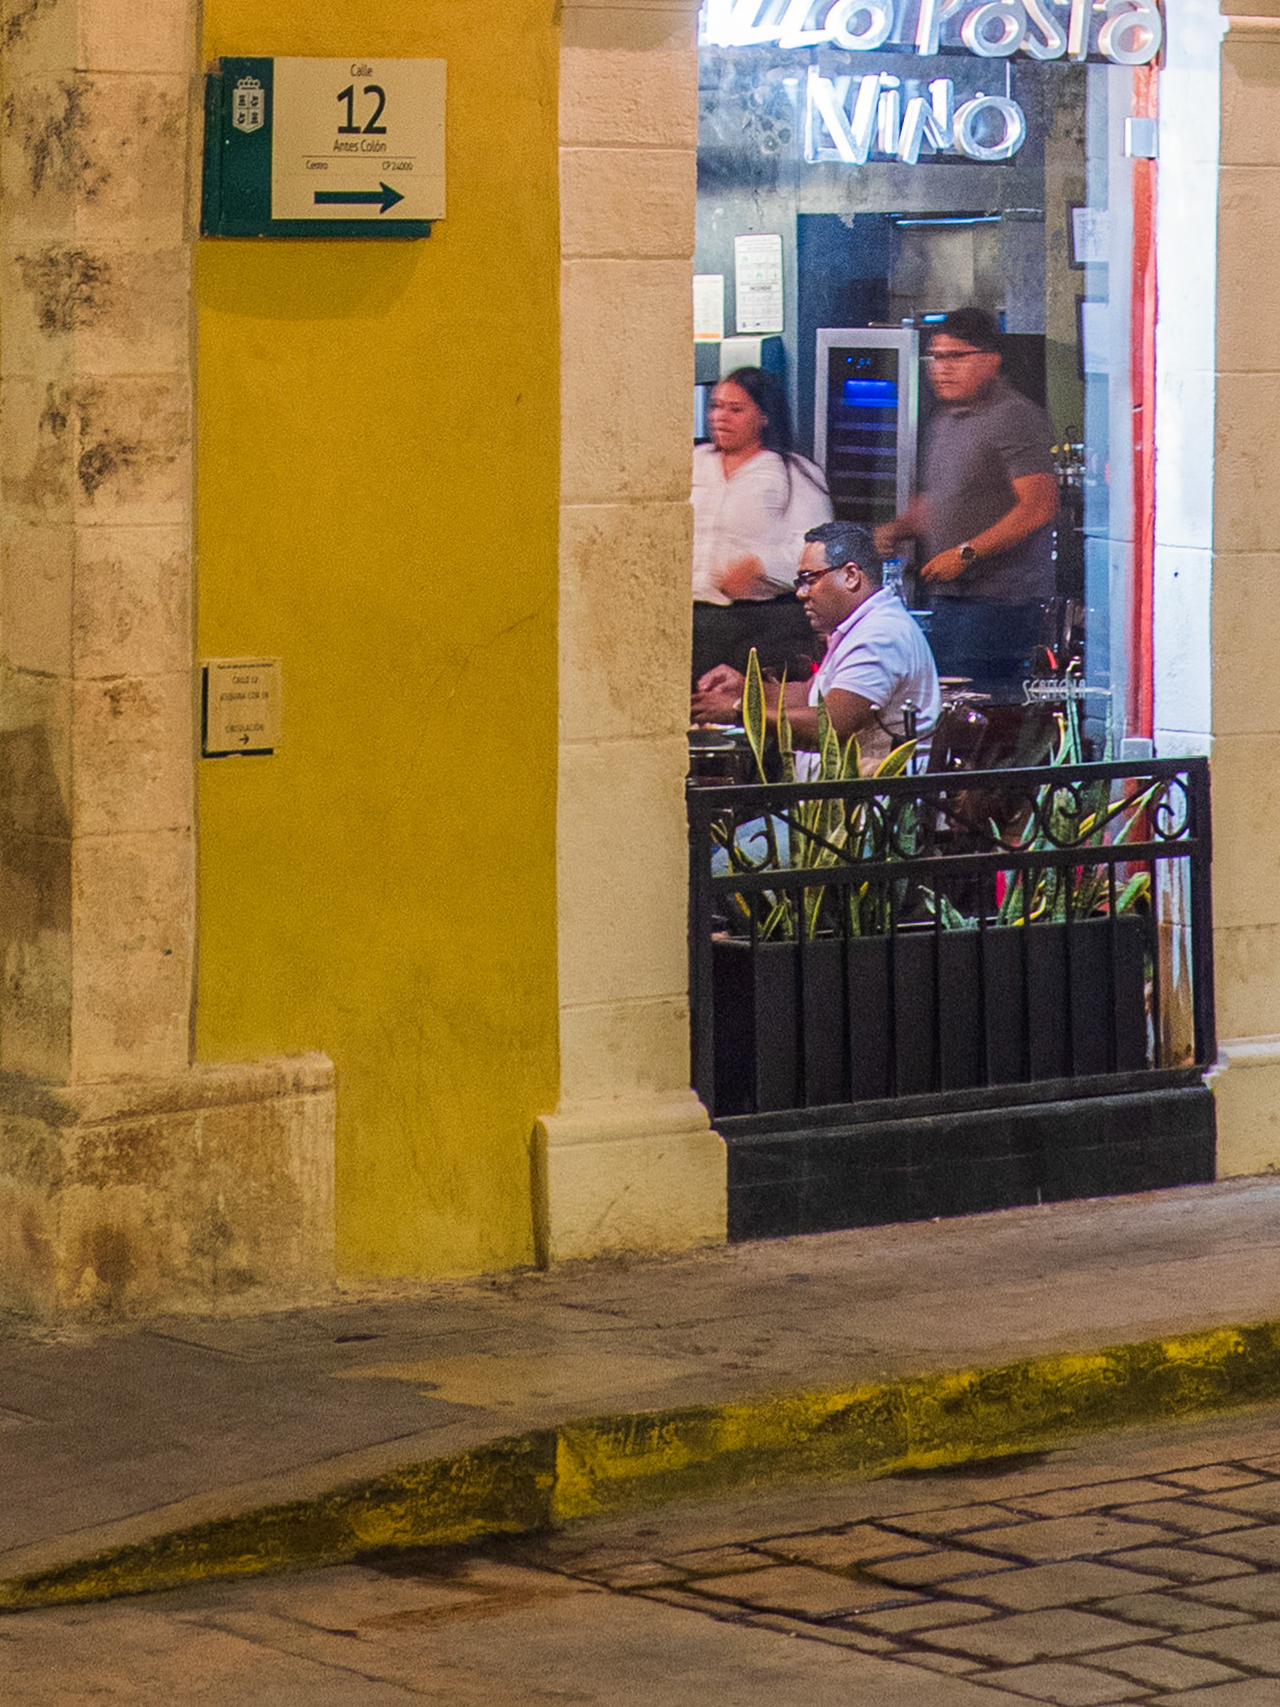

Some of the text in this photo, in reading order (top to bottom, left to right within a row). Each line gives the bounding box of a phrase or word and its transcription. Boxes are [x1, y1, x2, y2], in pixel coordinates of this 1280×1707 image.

[350, 63, 373, 77] Calle
[336, 83, 388, 135] 12
[332, 138, 387, 153] Antes Colón
